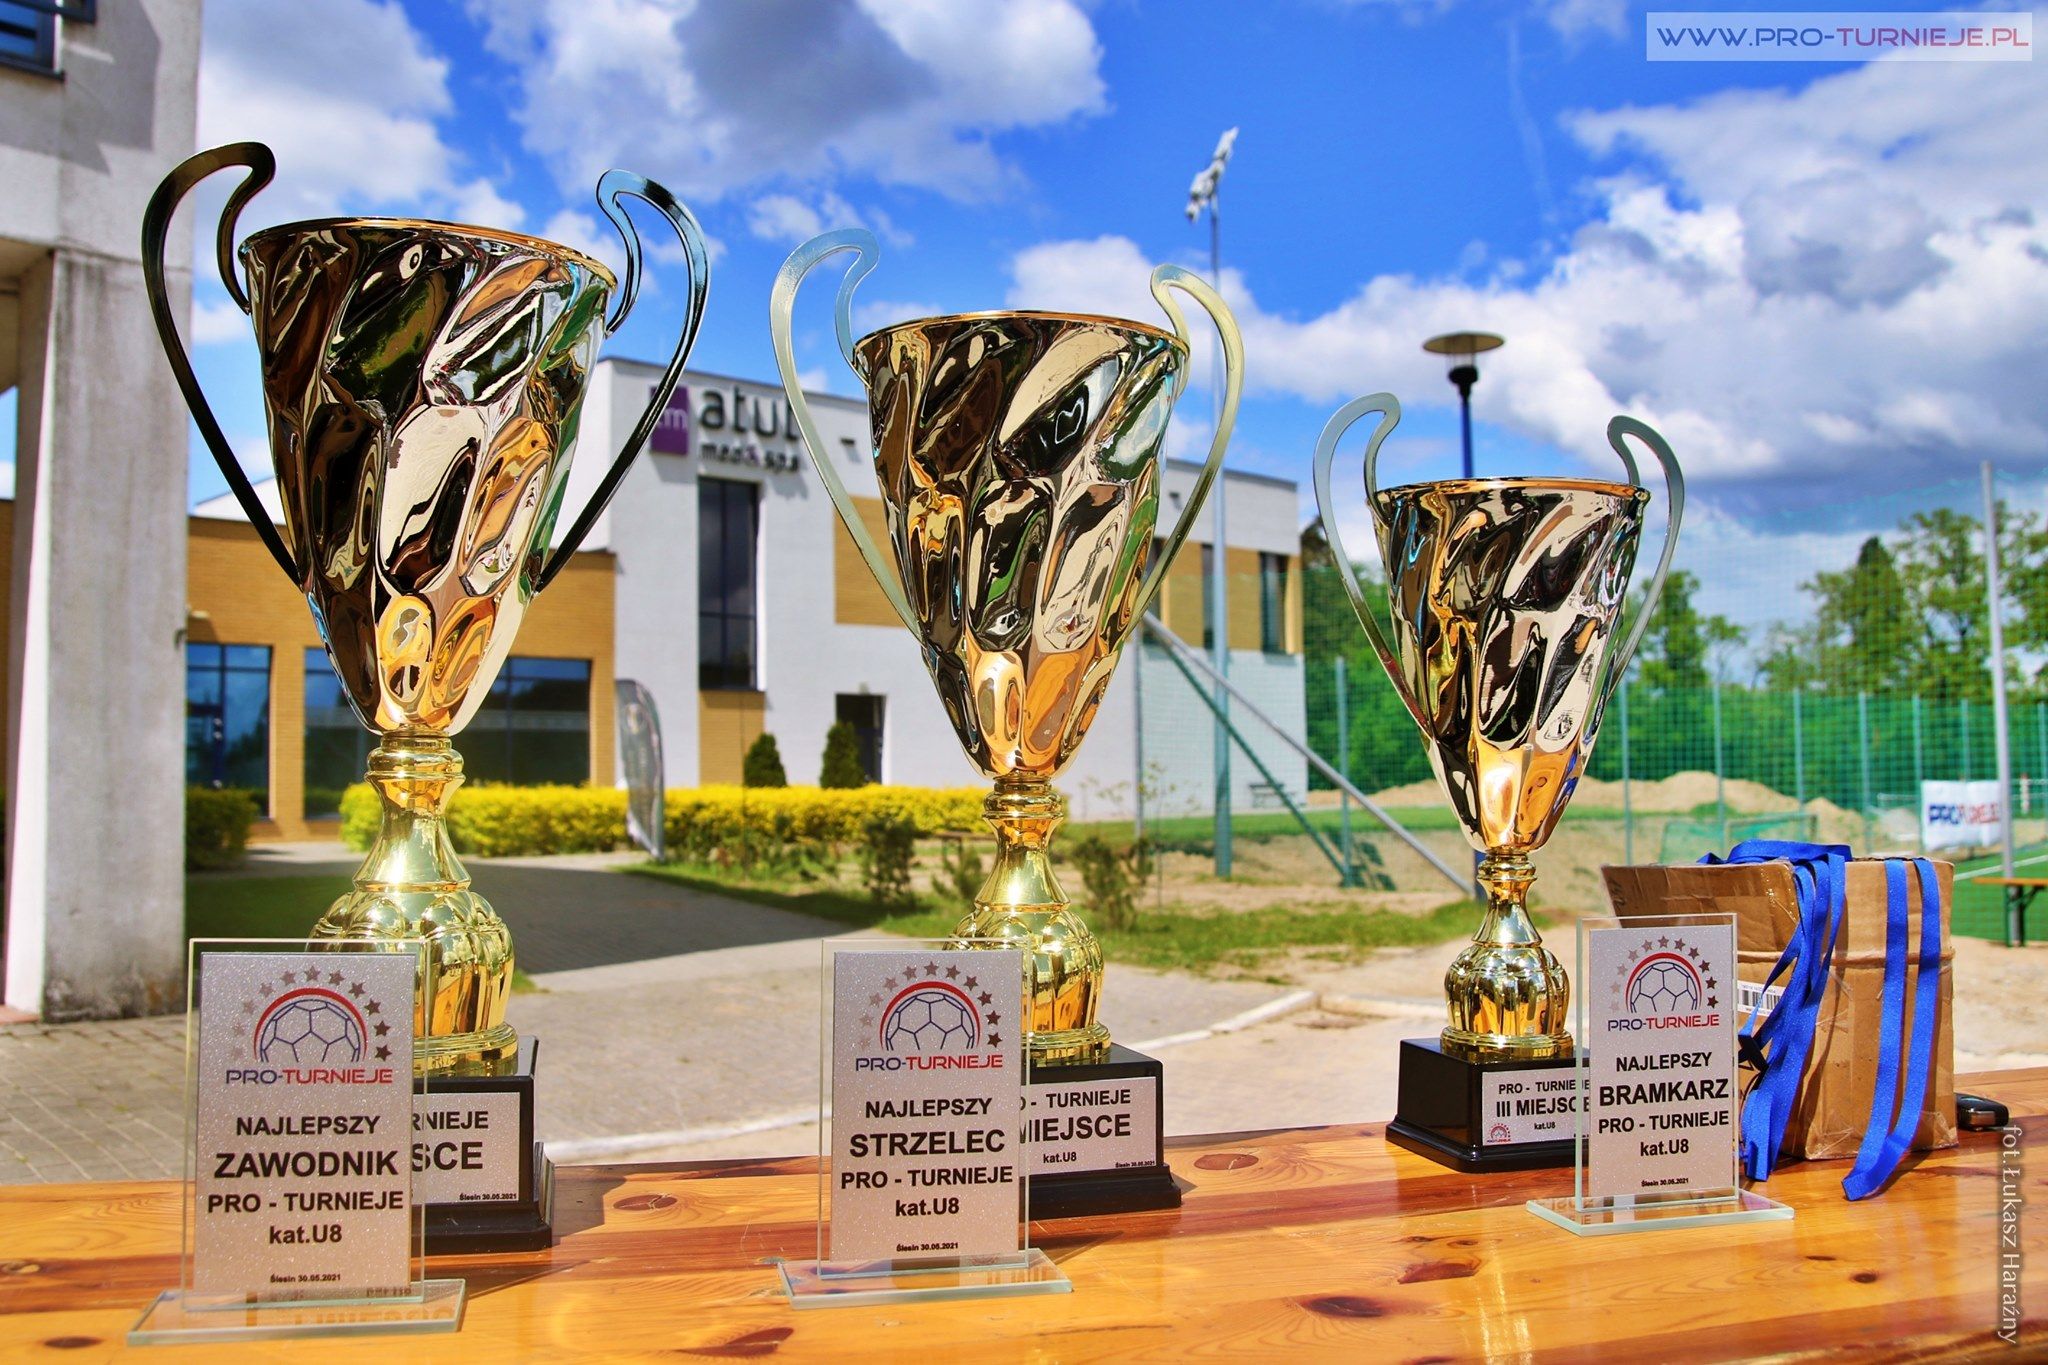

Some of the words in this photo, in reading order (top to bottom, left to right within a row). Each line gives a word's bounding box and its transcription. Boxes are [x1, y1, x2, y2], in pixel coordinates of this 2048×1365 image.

[1608, 1014, 1720, 1032] PRO-TURNIEJE
[855, 1054, 1003, 1071] PRO-TURNIEJE
[1616, 1052, 1712, 1072] NAJLEPSZY
[226, 1068, 393, 1085] PRO-TURNIEJE
[1046, 1089, 1131, 1108] TURNIEJE
[1499, 1083, 1523, 1094] PRO
[1599, 1078, 1729, 1107] BRAMKARZ
[865, 1097, 992, 1119] NAJLEPSZY
[1496, 1101, 1511, 1117] III
[236, 1115, 380, 1136] NAJLEPSZY
[1599, 1116, 1634, 1134] PRO
[1649, 1110, 1729, 1132] TURNIEJE
[849, 1129, 1006, 1158] STRZELEC
[1640, 1139, 1689, 1157] kat.U8
[214, 1150, 399, 1178] ZAWODNIK
[1043, 1151, 1077, 1164] kat.U8
[841, 1171, 888, 1189] PRO
[907, 1165, 1013, 1188] TURNIEJE
[208, 1193, 261, 1213] PRO
[284, 1190, 404, 1212] TURNIEJE
[895, 1196, 959, 1217] kat.U8
[269, 1224, 342, 1244] kat.U8
